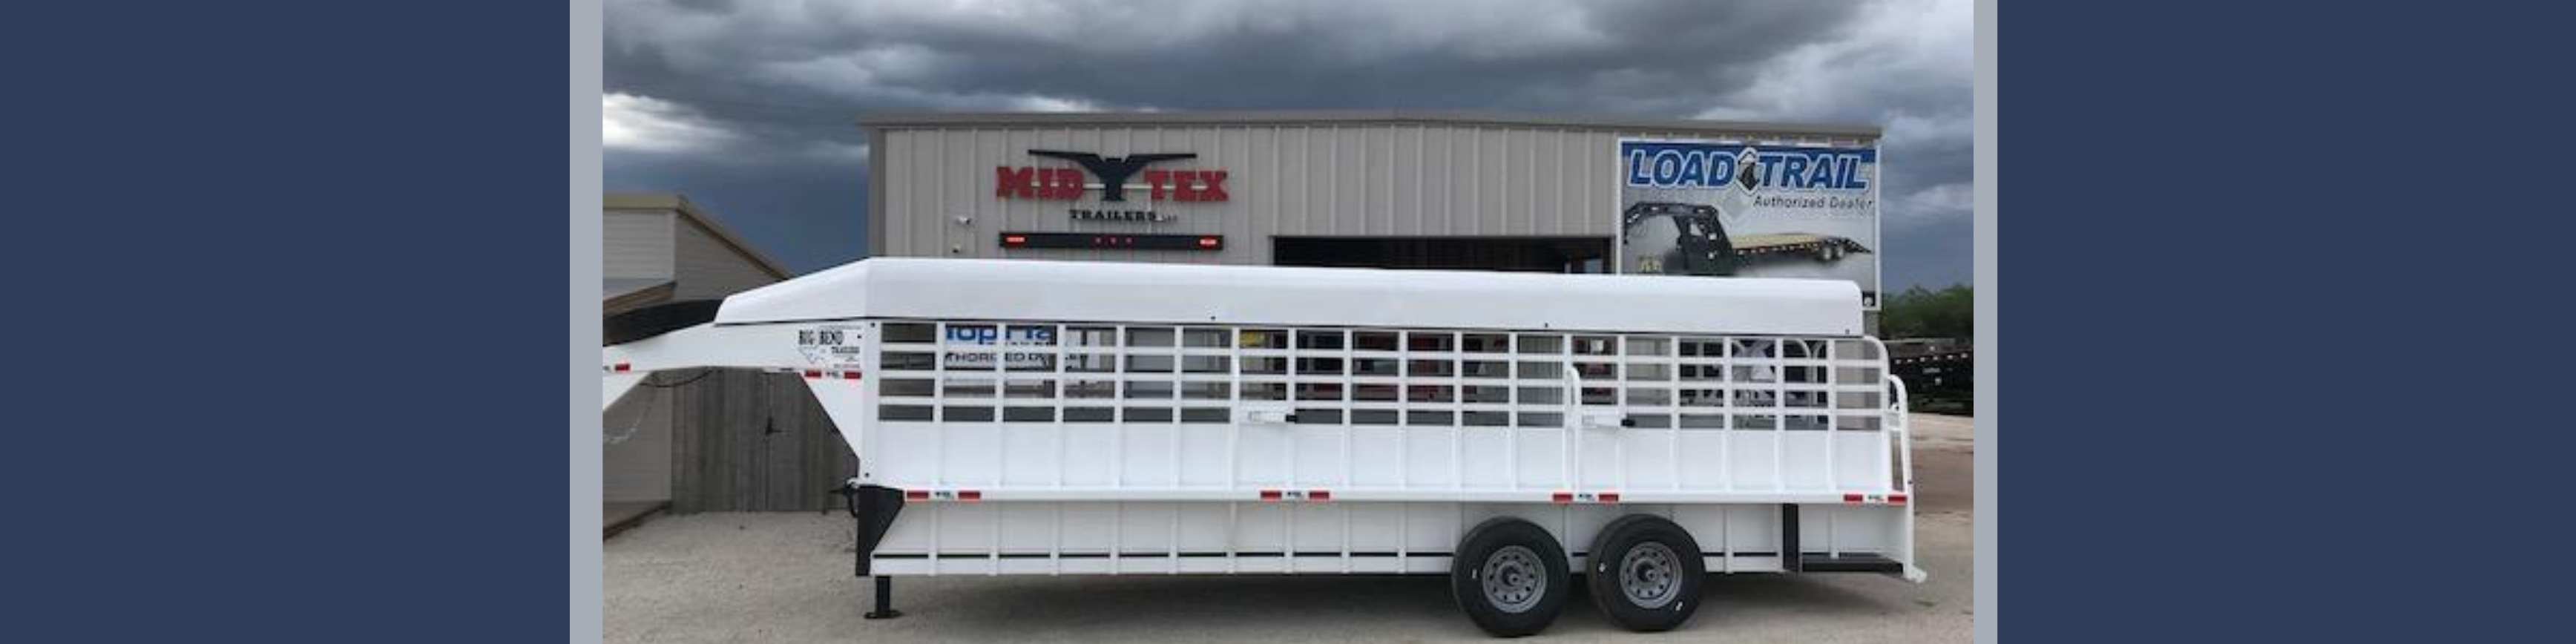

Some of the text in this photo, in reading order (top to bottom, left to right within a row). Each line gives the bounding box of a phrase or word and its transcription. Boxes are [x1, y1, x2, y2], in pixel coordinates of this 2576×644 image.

[1629, 149, 1870, 190] LOAD TRAIL
[996, 166, 1228, 202] MID TEX
[1069, 209, 1156, 222] TRAILERS
[1753, 195, 1873, 211] Authorized Dealer
